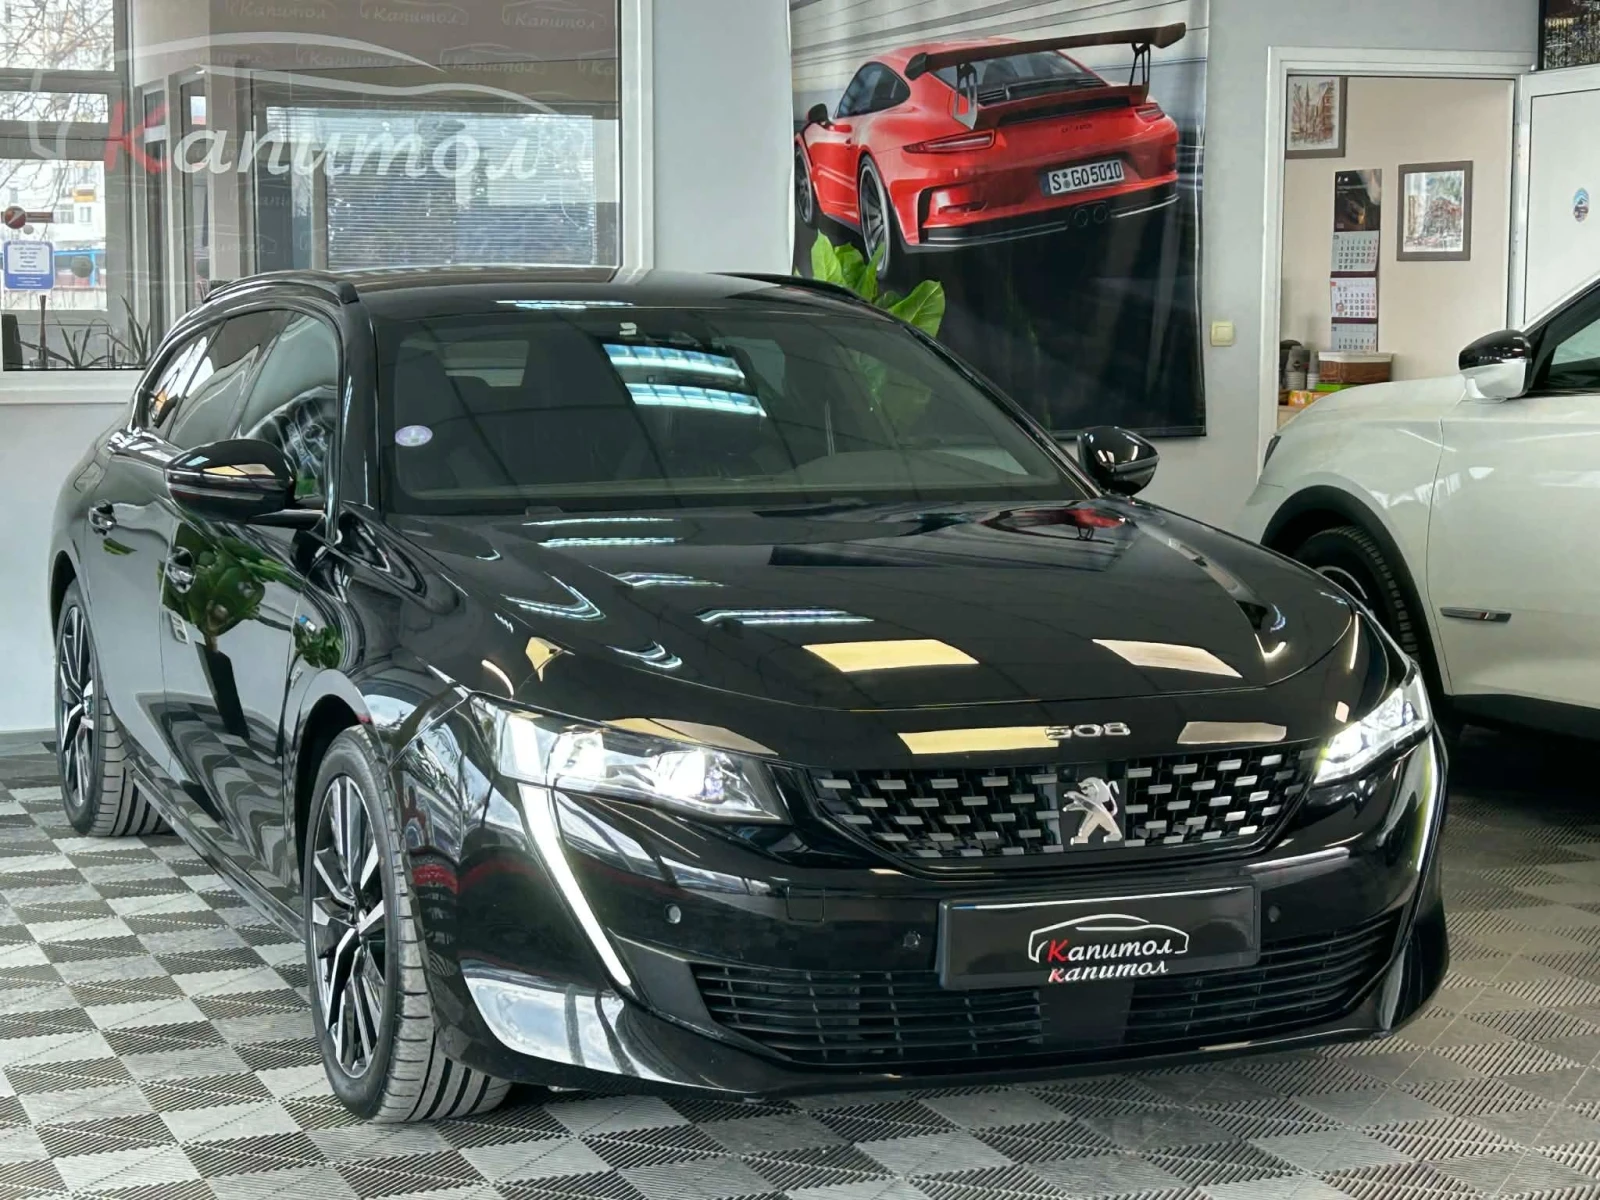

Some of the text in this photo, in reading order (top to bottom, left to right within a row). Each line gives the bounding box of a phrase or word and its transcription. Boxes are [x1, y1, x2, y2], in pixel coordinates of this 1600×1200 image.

[103, 100, 538, 180] Капитол
[1051, 173, 1062, 192] S
[1045, 721, 1131, 740] 508
[1047, 938, 1173, 963] Капитол
